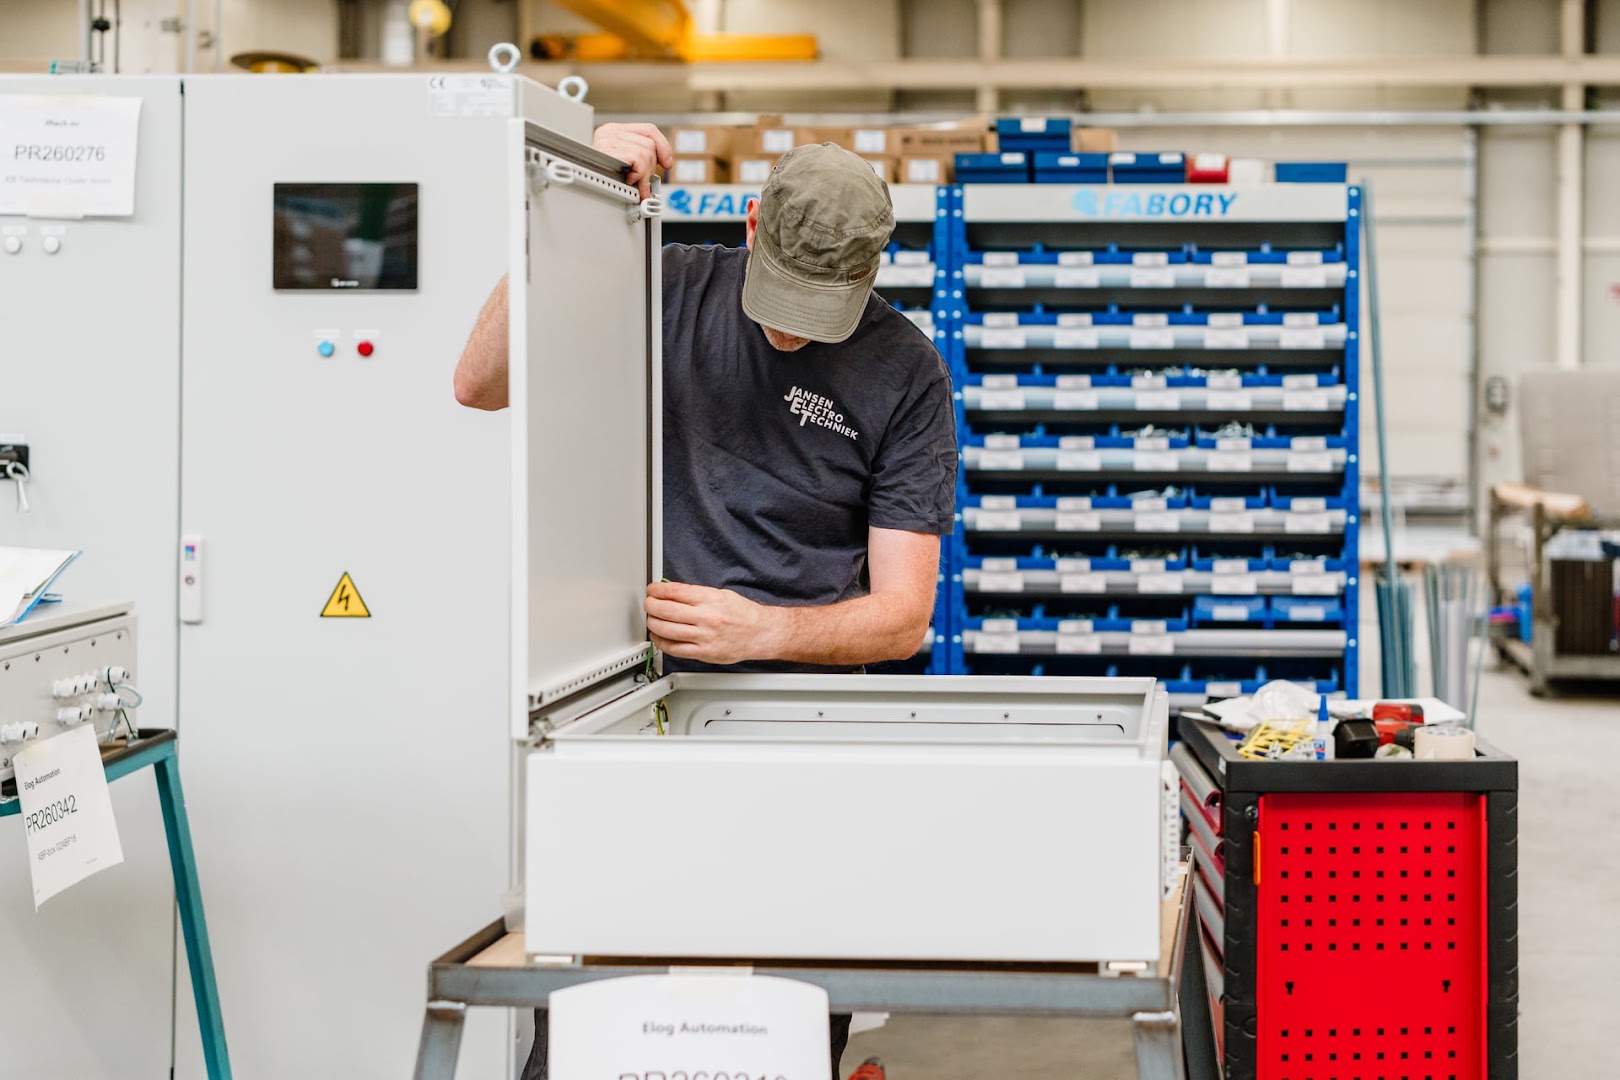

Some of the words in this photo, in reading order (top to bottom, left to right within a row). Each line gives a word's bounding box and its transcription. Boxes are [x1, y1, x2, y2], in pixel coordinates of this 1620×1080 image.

[14, 144, 105, 161] PR260276
[1102, 193, 1238, 216] FABORY
[783, 385, 834, 409] JANSEN
[789, 396, 844, 423] ELECTRO
[799, 409, 859, 440] TECHNIEK
[24, 780, 34, 791] Elog
[34, 767, 61, 785] Automation
[26, 794, 78, 837] PR260342
[643, 1021, 675, 1036] Elog
[680, 1021, 768, 1036] Automation
